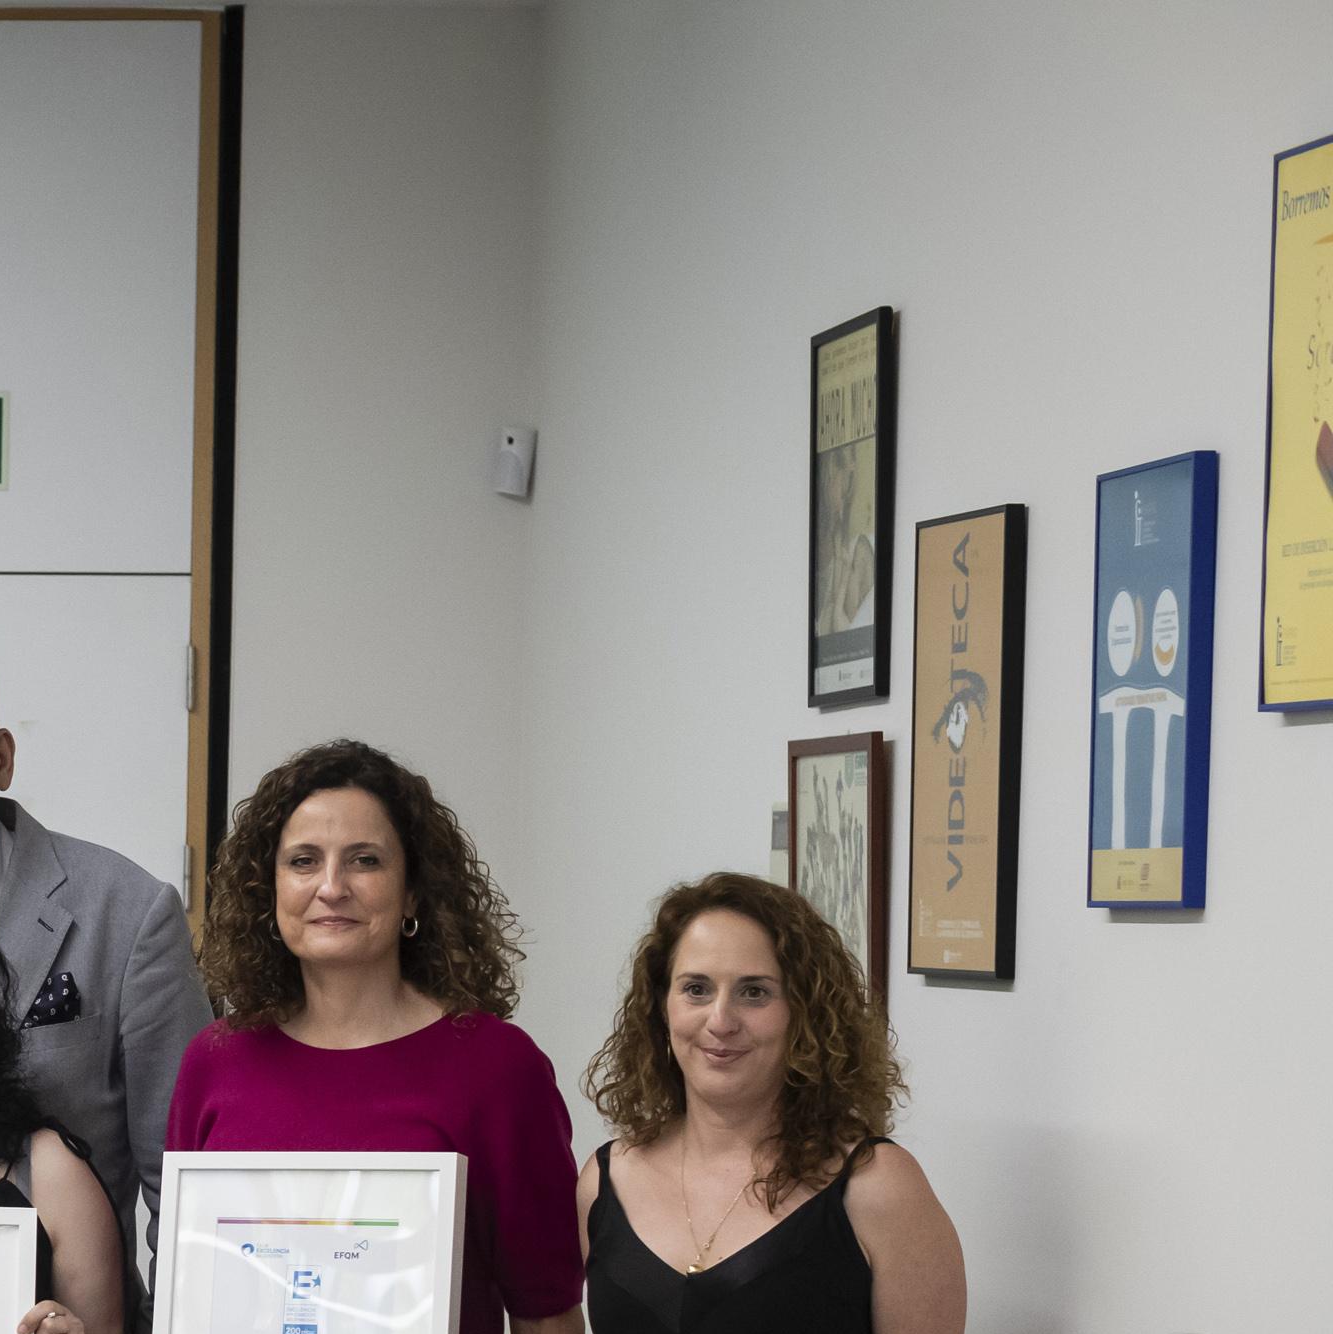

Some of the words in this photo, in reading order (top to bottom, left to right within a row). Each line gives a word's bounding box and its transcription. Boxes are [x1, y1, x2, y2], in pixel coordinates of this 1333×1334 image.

[1281, 186, 1331, 222] Borremos
[334, 1252, 359, 1260] EFQM
[285, 1327, 301, 1334] 200
